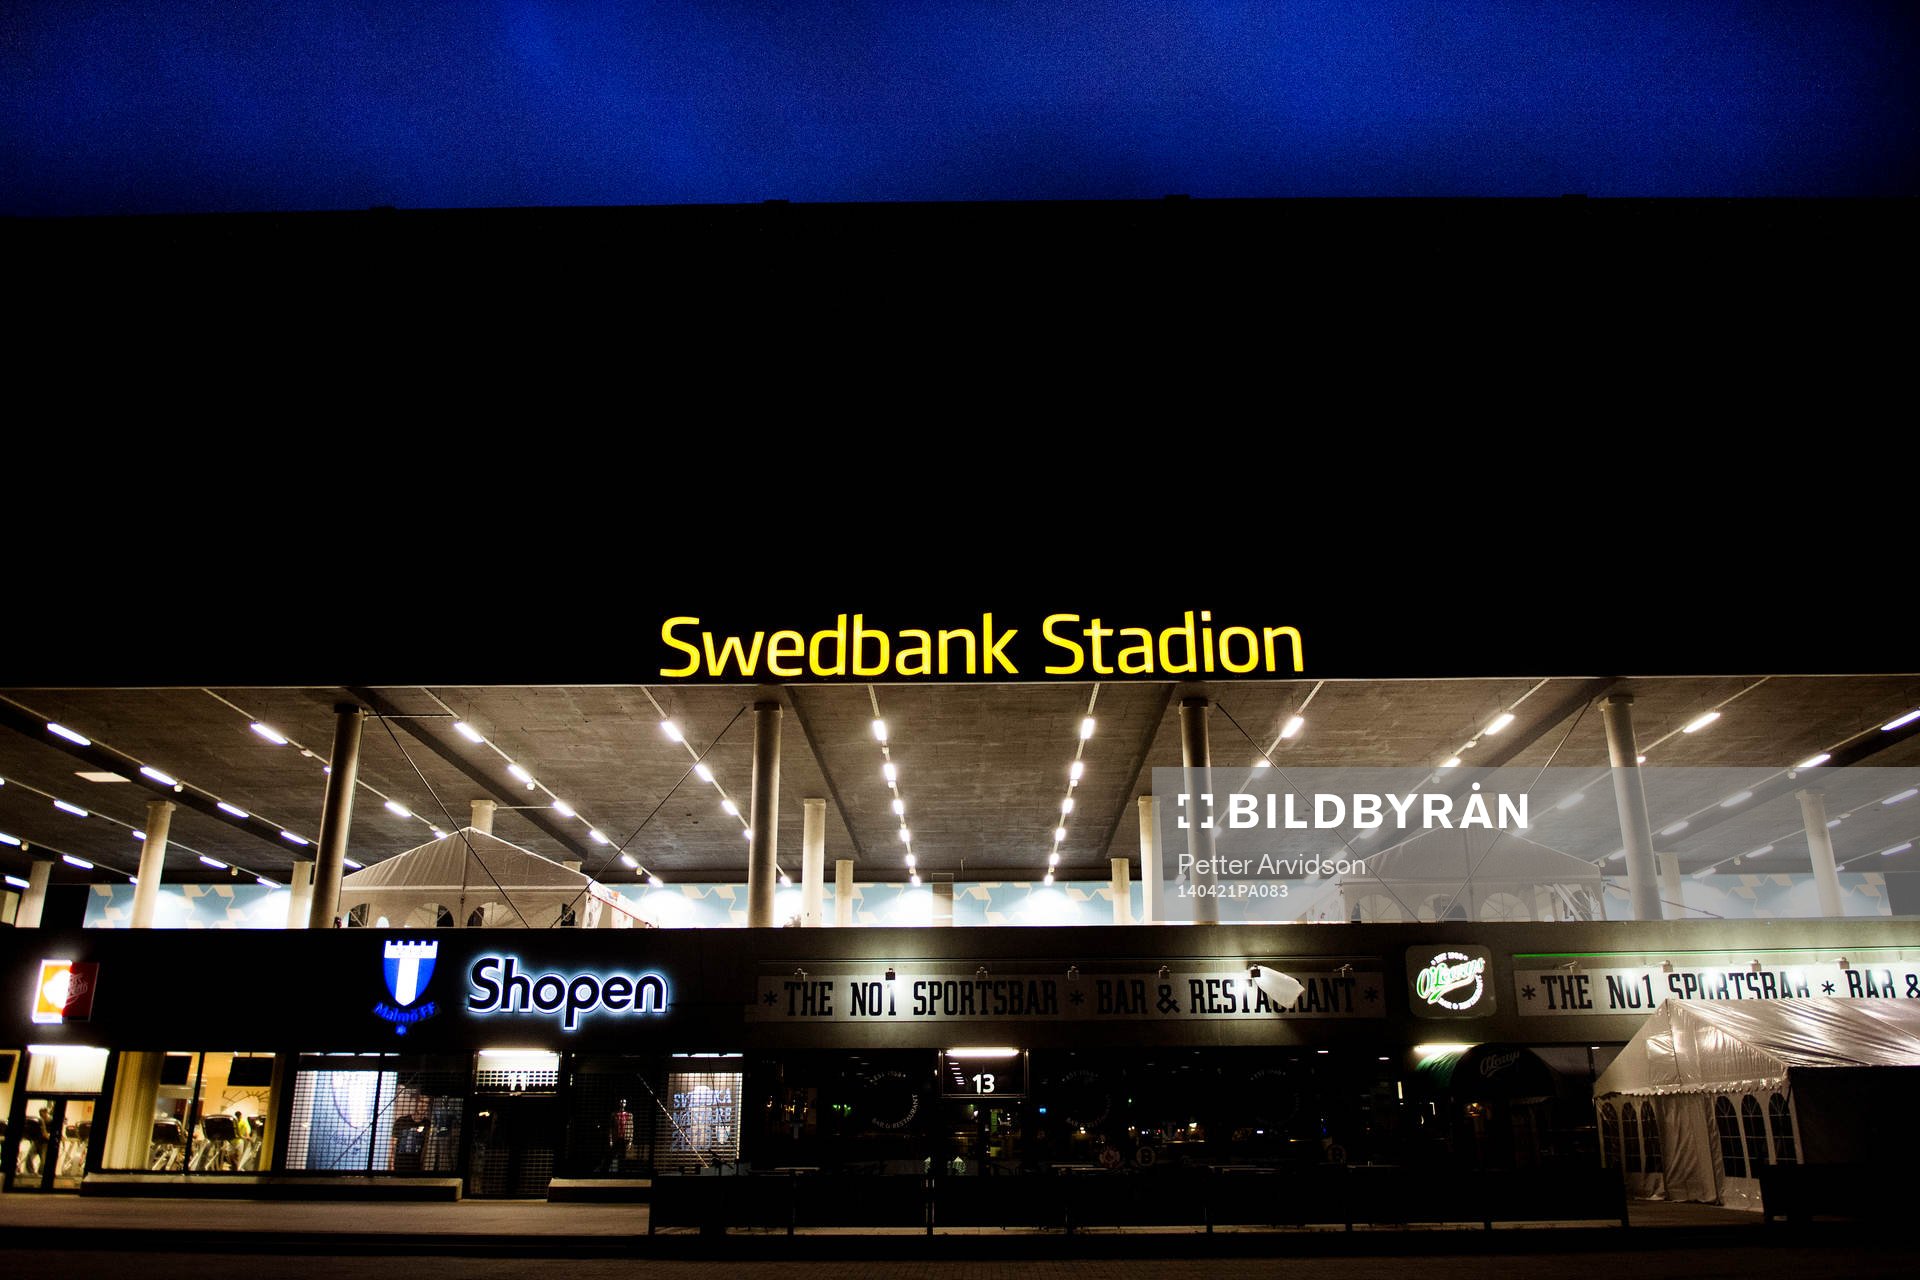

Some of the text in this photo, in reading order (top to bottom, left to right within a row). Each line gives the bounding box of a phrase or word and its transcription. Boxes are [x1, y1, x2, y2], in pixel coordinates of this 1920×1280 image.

[660, 610, 1304, 677] Swedbank Stadion
[467, 954, 669, 1031] Shopen
[783, 980, 834, 1017] THE
[913, 979, 1059, 1017] SPORTSBAR
[1096, 979, 1149, 1015] BAR
[1156, 983, 1181, 1014] &
[1188, 977, 1356, 1015] RESTARANT
[1540, 974, 1593, 1010] THE
[374, 1001, 419, 1023] Malmö
[972, 1073, 995, 1094] 13
